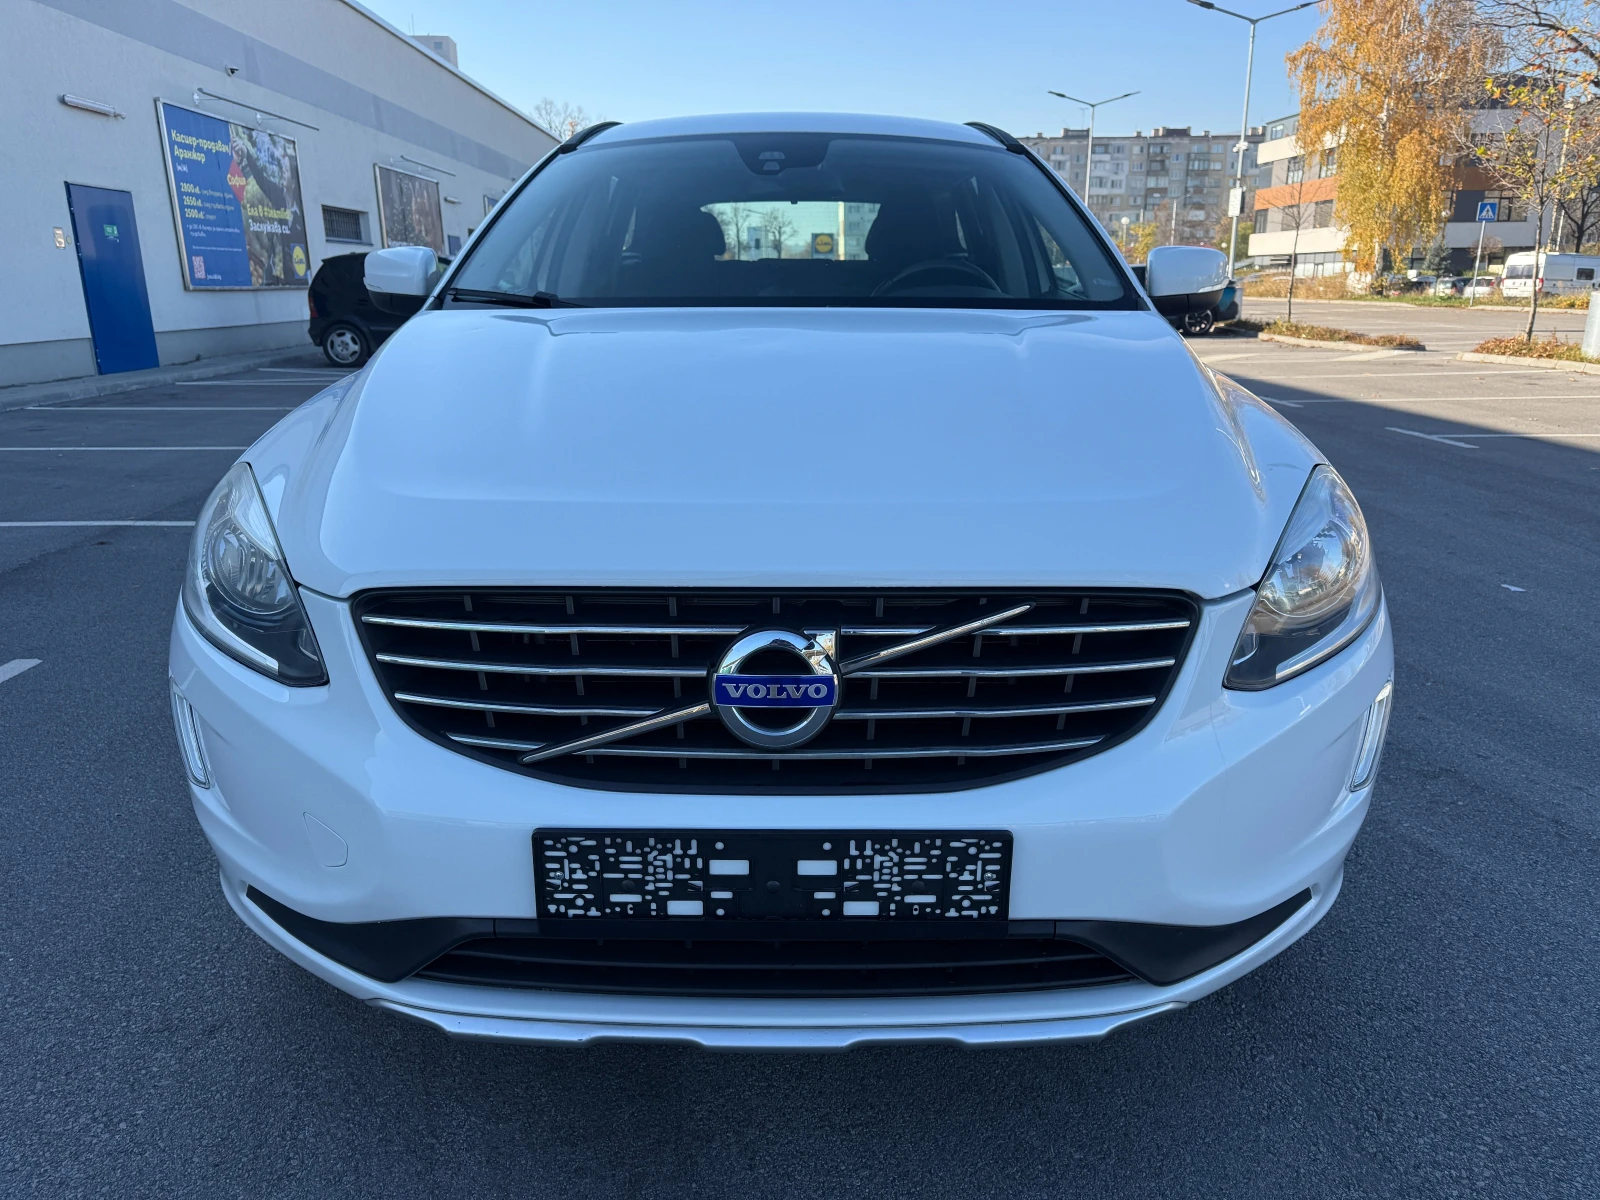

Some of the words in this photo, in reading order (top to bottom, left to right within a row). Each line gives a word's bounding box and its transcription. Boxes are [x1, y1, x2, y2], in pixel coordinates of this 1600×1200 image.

[227, 174, 246, 188] София
[246, 204, 259, 216] Ела
[249, 219, 282, 234] Заслужава
[722, 683, 828, 699] VOLVO
